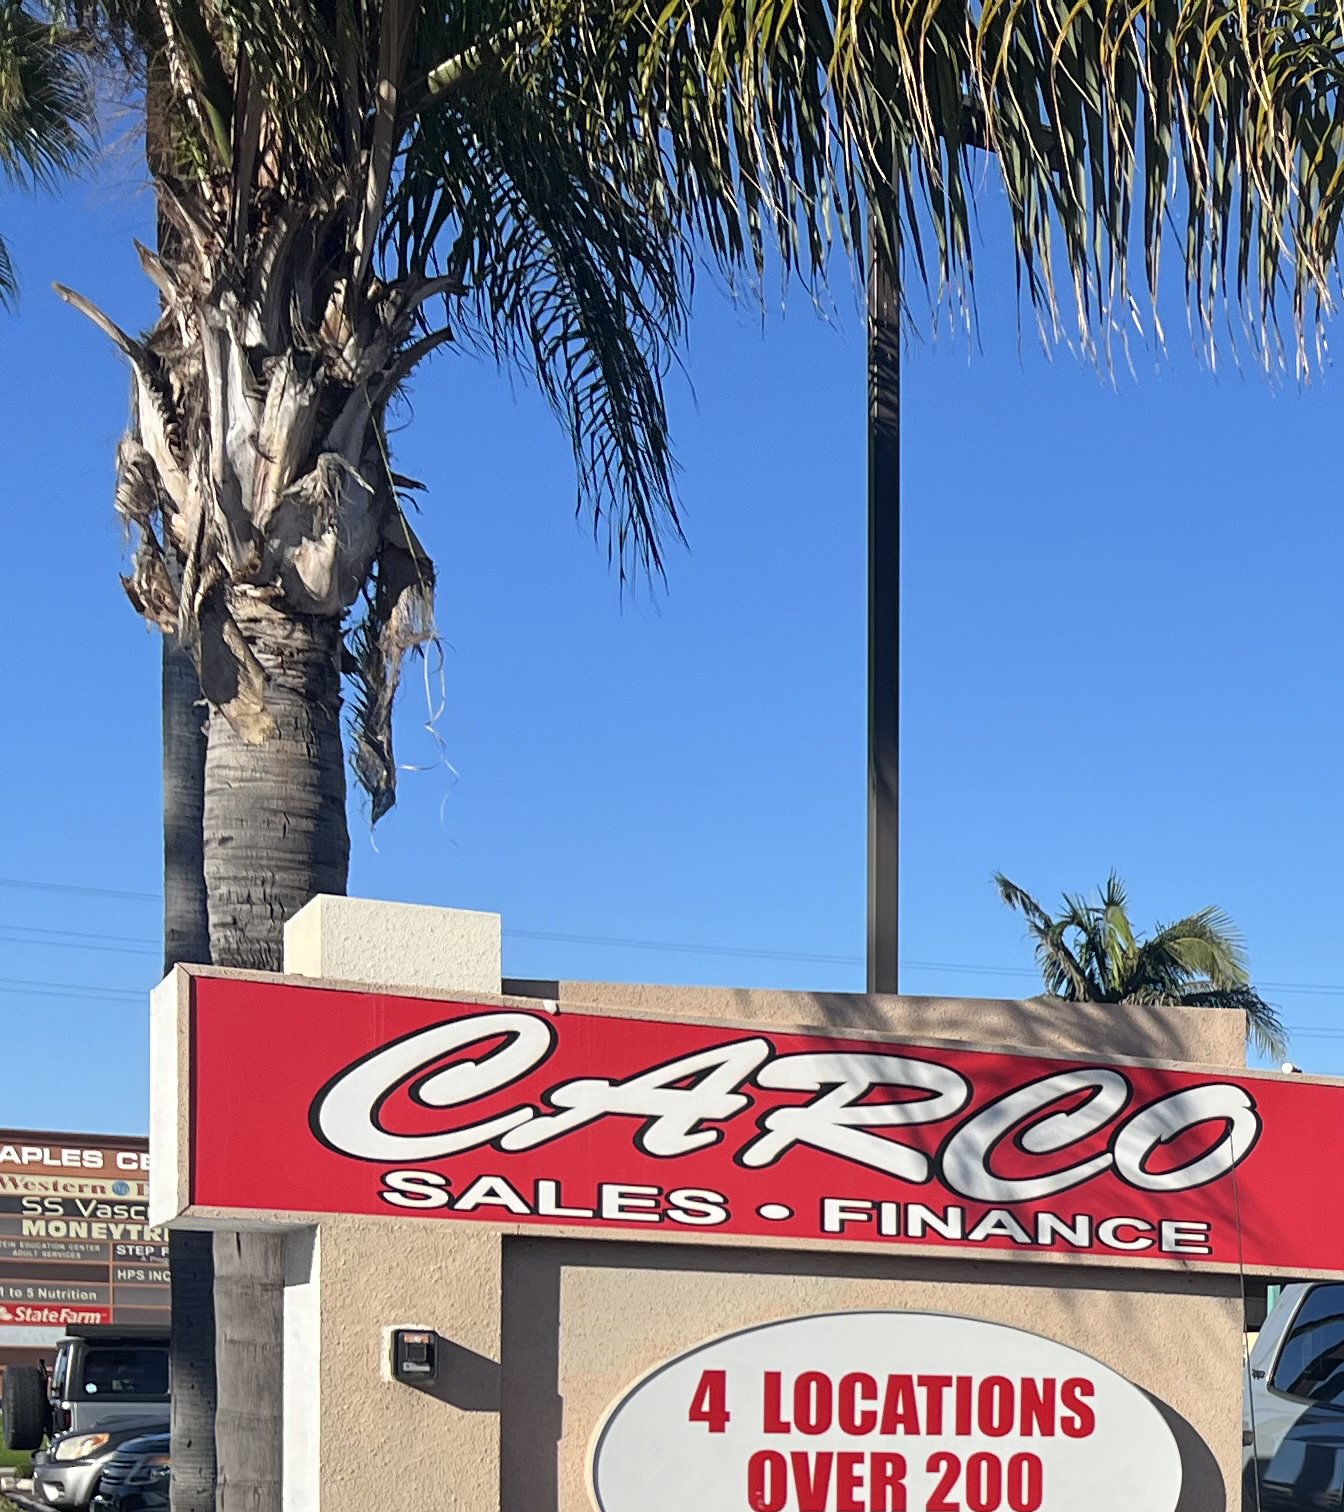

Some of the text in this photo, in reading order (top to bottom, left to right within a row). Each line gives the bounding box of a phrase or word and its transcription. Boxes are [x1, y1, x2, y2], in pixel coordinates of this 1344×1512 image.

[307, 1009, 1262, 1202] CARCO
[22, 1196, 149, 1220] SS Vasc
[379, 1168, 1213, 1258] SALES FINANCE
[19, 1240, 66, 1251] EDUCATION
[68, 1242, 101, 1252] CENTER
[116, 1244, 155, 1257] STEP
[12, 1248, 82, 1260] ADULT SERVICES
[117, 1269, 171, 1283] HPS INC
[9, 1287, 23, 1299] to
[26, 1287, 34, 1299] 5
[38, 1288, 97, 1301] Nutrition
[687, 1369, 1097, 1439] 4 LOCATIONS
